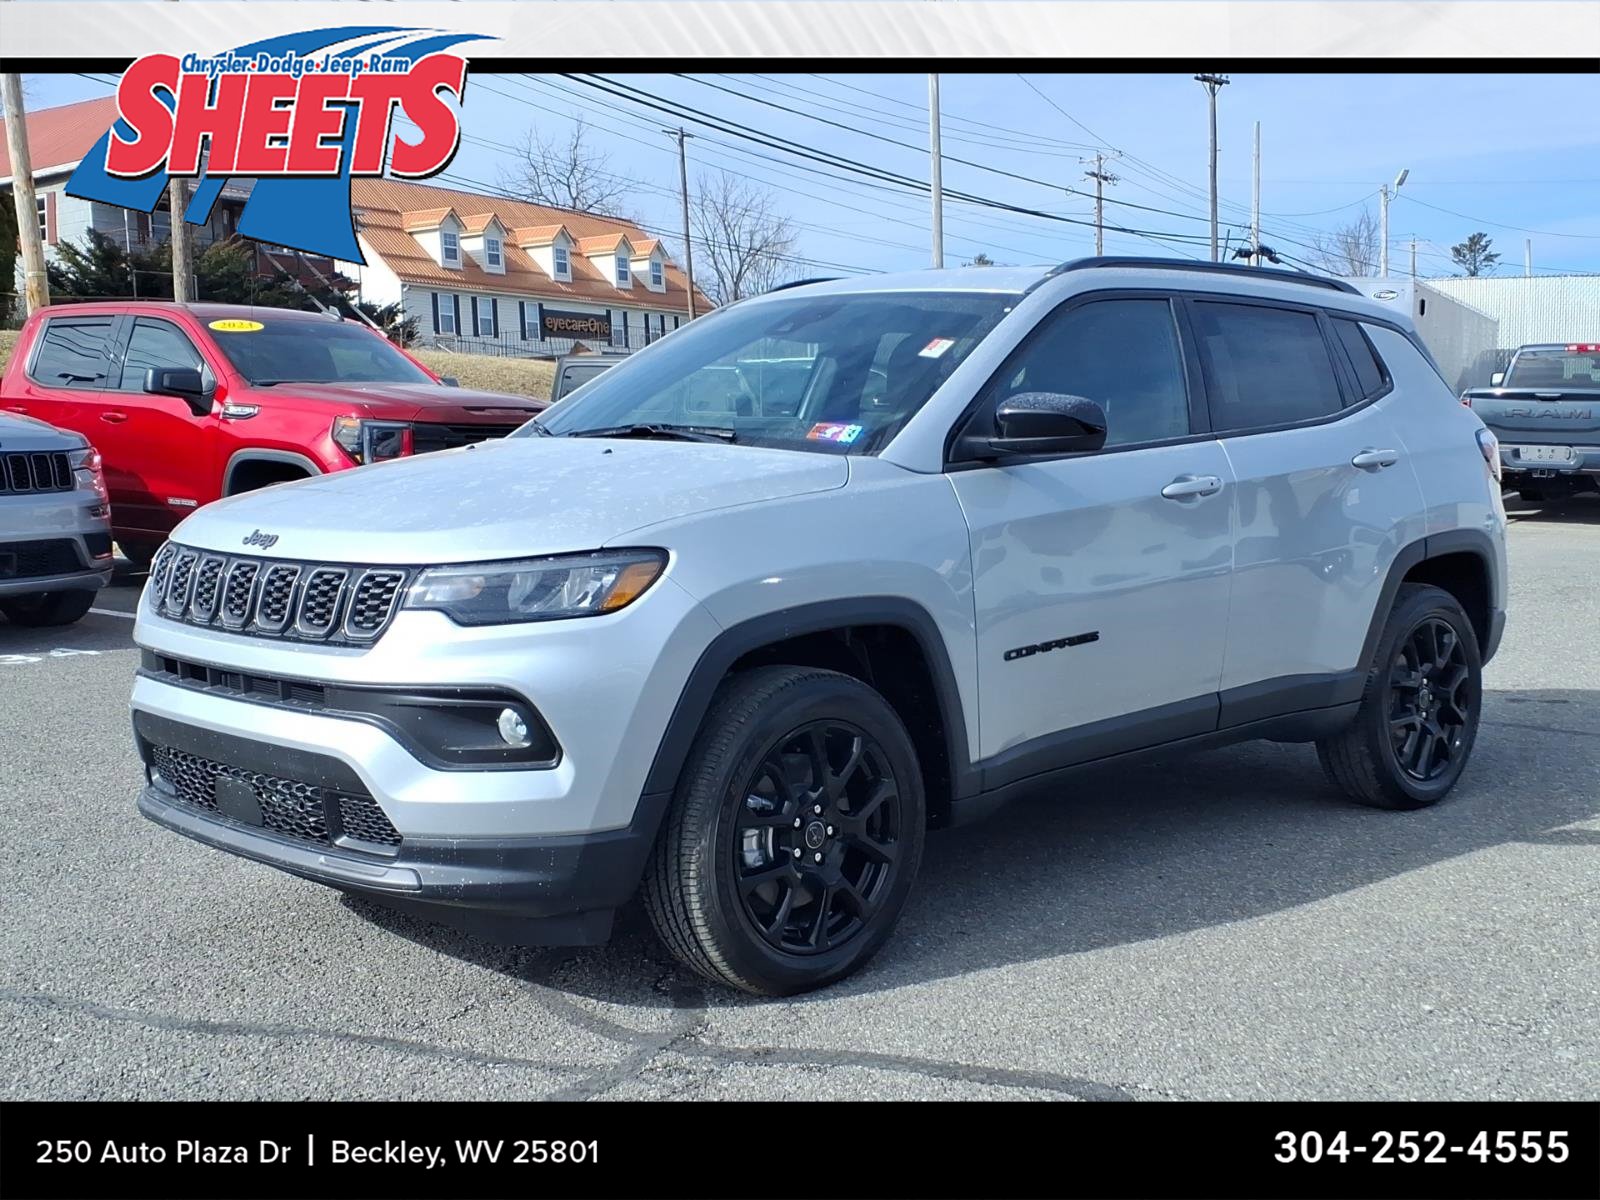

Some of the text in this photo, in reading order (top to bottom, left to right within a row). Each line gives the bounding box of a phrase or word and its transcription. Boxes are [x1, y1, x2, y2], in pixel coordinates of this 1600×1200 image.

[1503, 407, 1592, 420] RAM
[242, 528, 279, 551] Jeep
[1003, 630, 1100, 662] COMPASS
